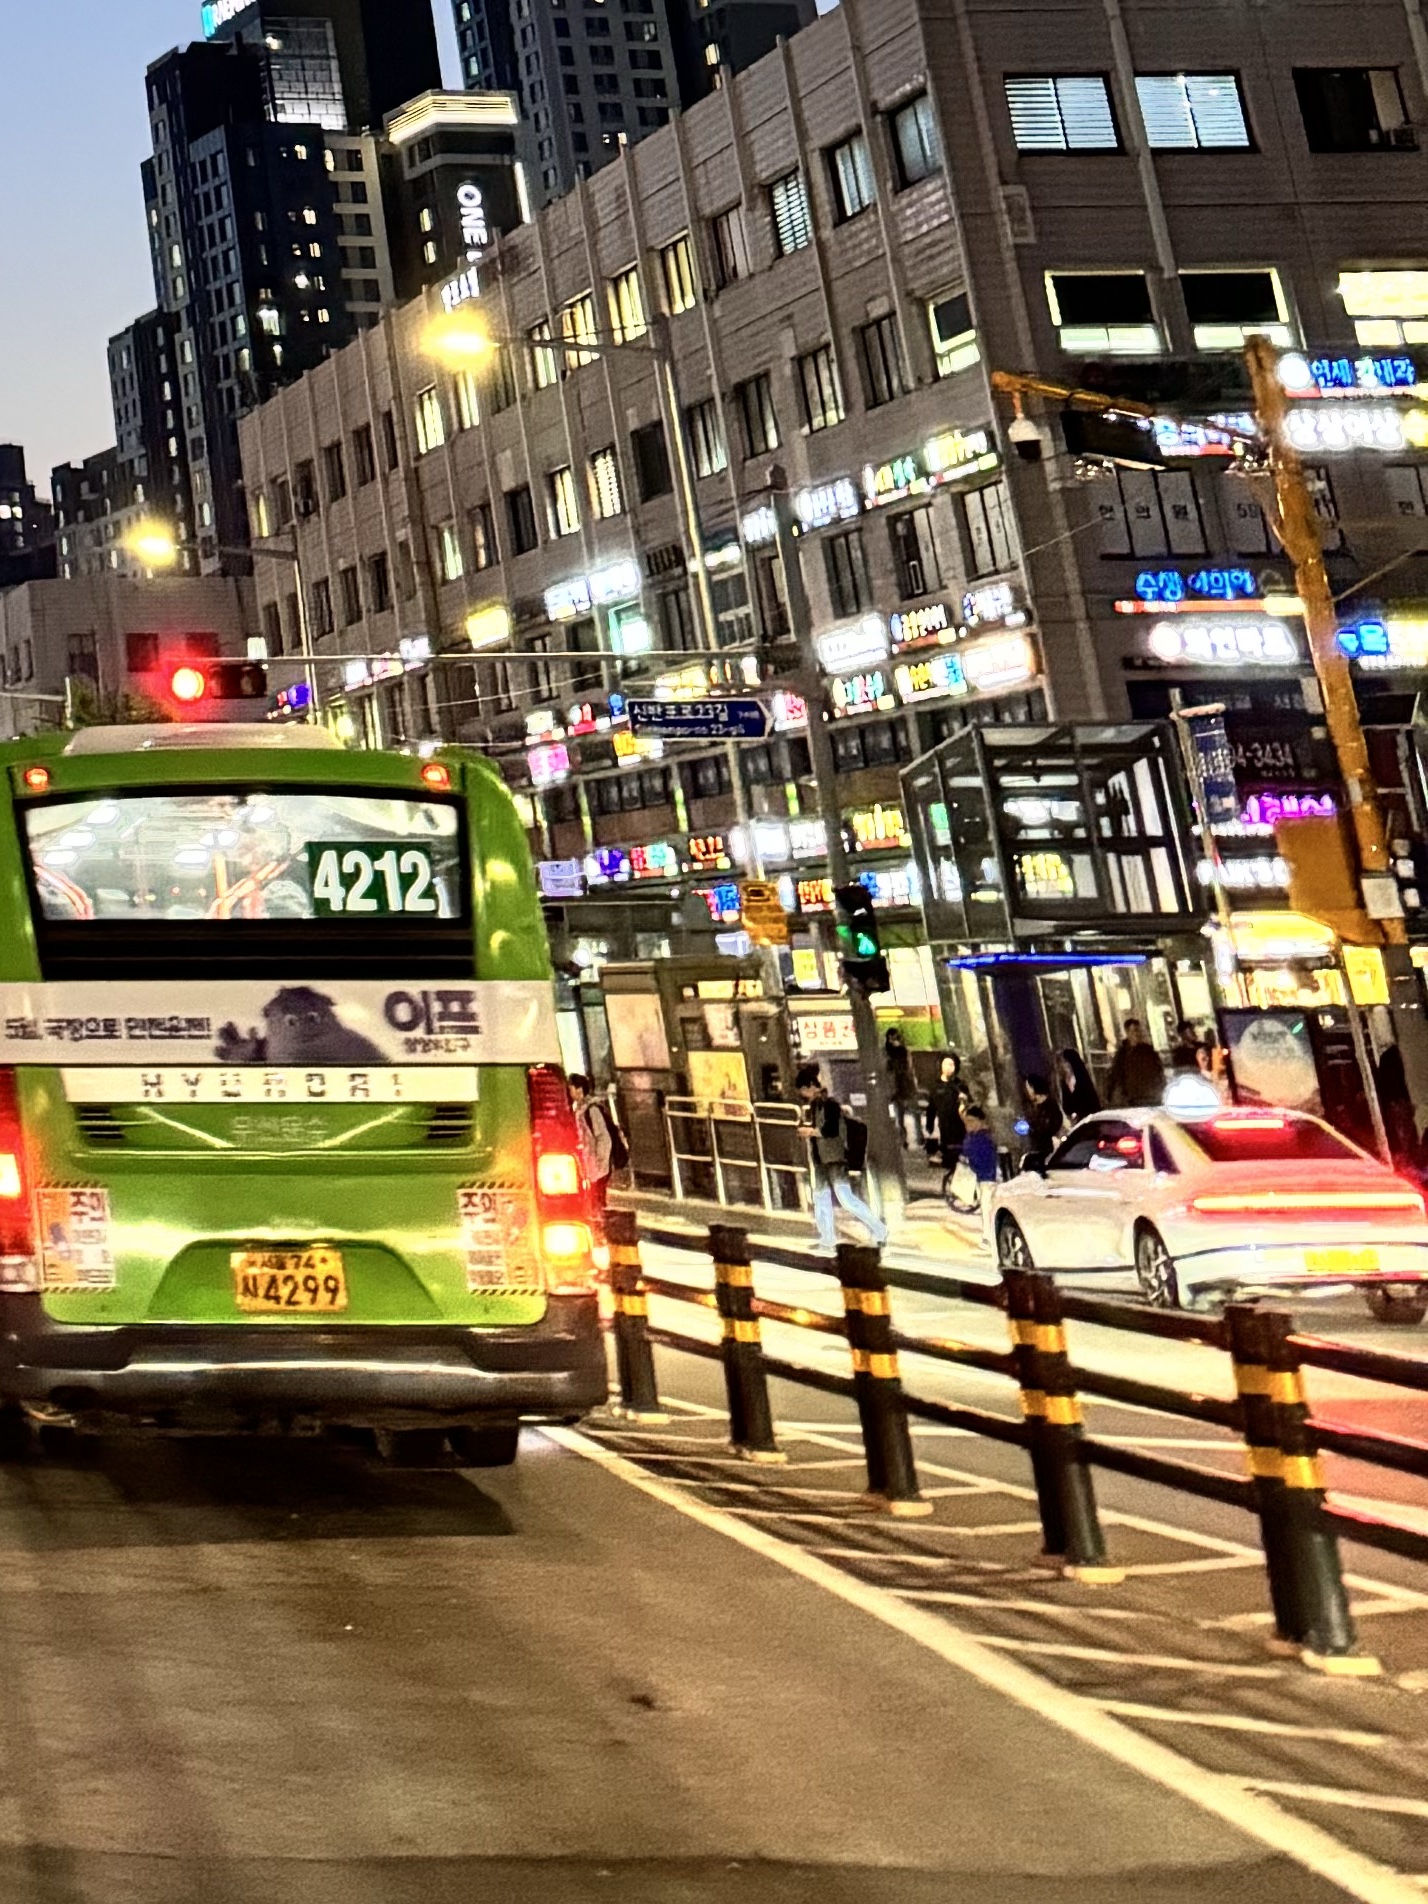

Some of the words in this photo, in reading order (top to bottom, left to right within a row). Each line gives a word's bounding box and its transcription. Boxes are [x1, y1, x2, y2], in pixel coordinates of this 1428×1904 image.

[314, 850, 435, 911] 4212
[385, 990, 481, 1034] 이프
[141, 1073, 403, 1098] HYUNDAI
